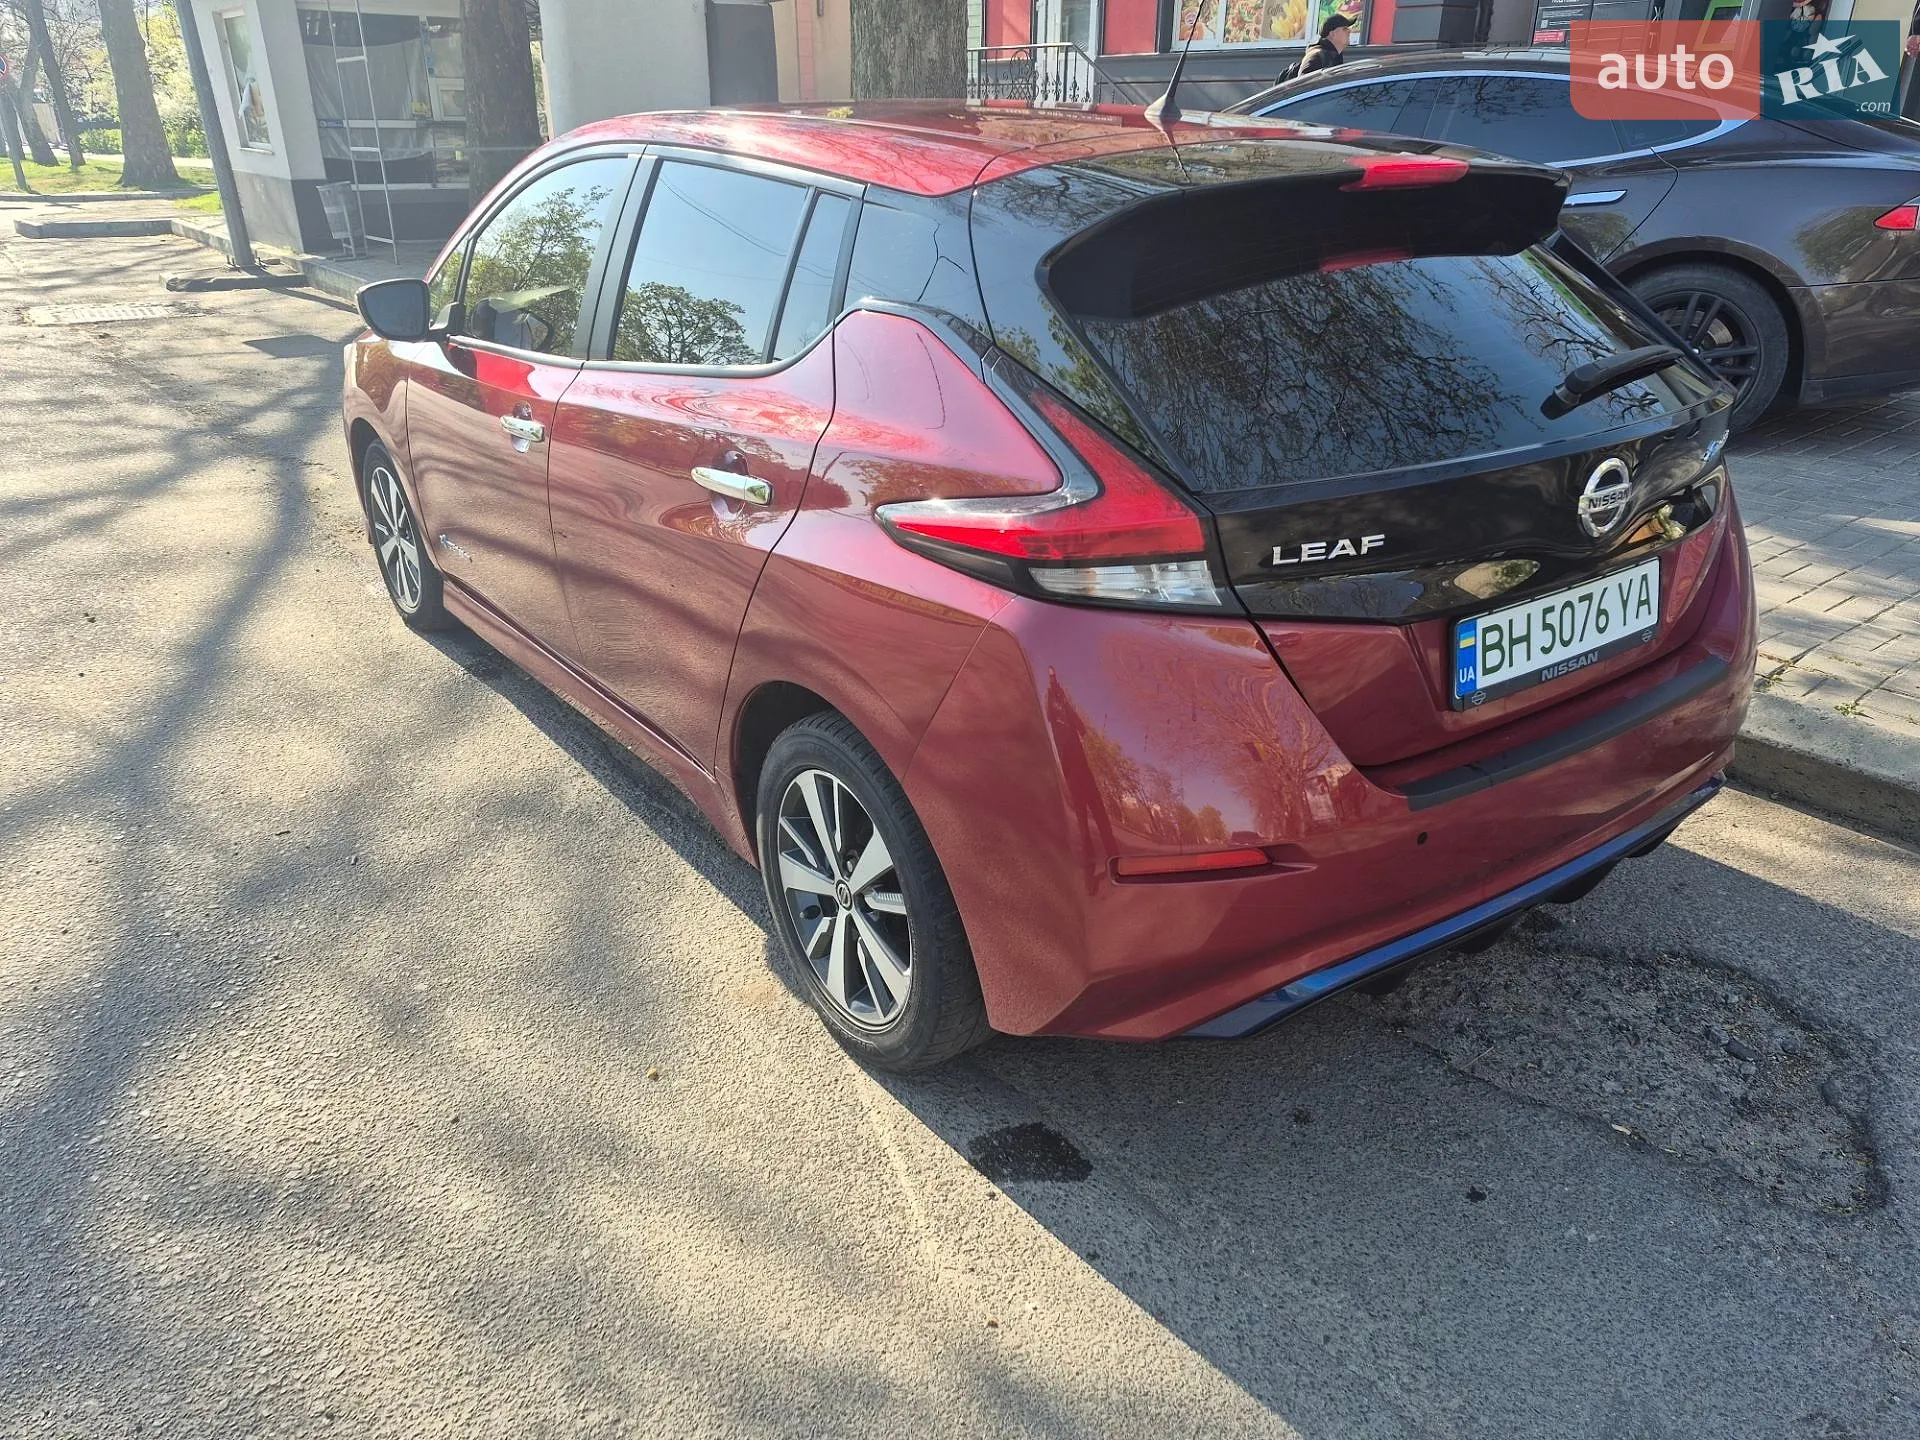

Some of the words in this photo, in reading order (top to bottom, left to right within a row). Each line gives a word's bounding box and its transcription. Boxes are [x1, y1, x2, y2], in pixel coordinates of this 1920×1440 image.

[1588, 488, 1630, 510] NISSAN
[1272, 533, 1385, 566] LEAF
[1481, 612, 1532, 677] BH
[1540, 586, 1610, 655] 5076
[1618, 573, 1652, 627] YA
[1459, 665, 1475, 684] UA
[1541, 650, 1601, 682] NISSAN
